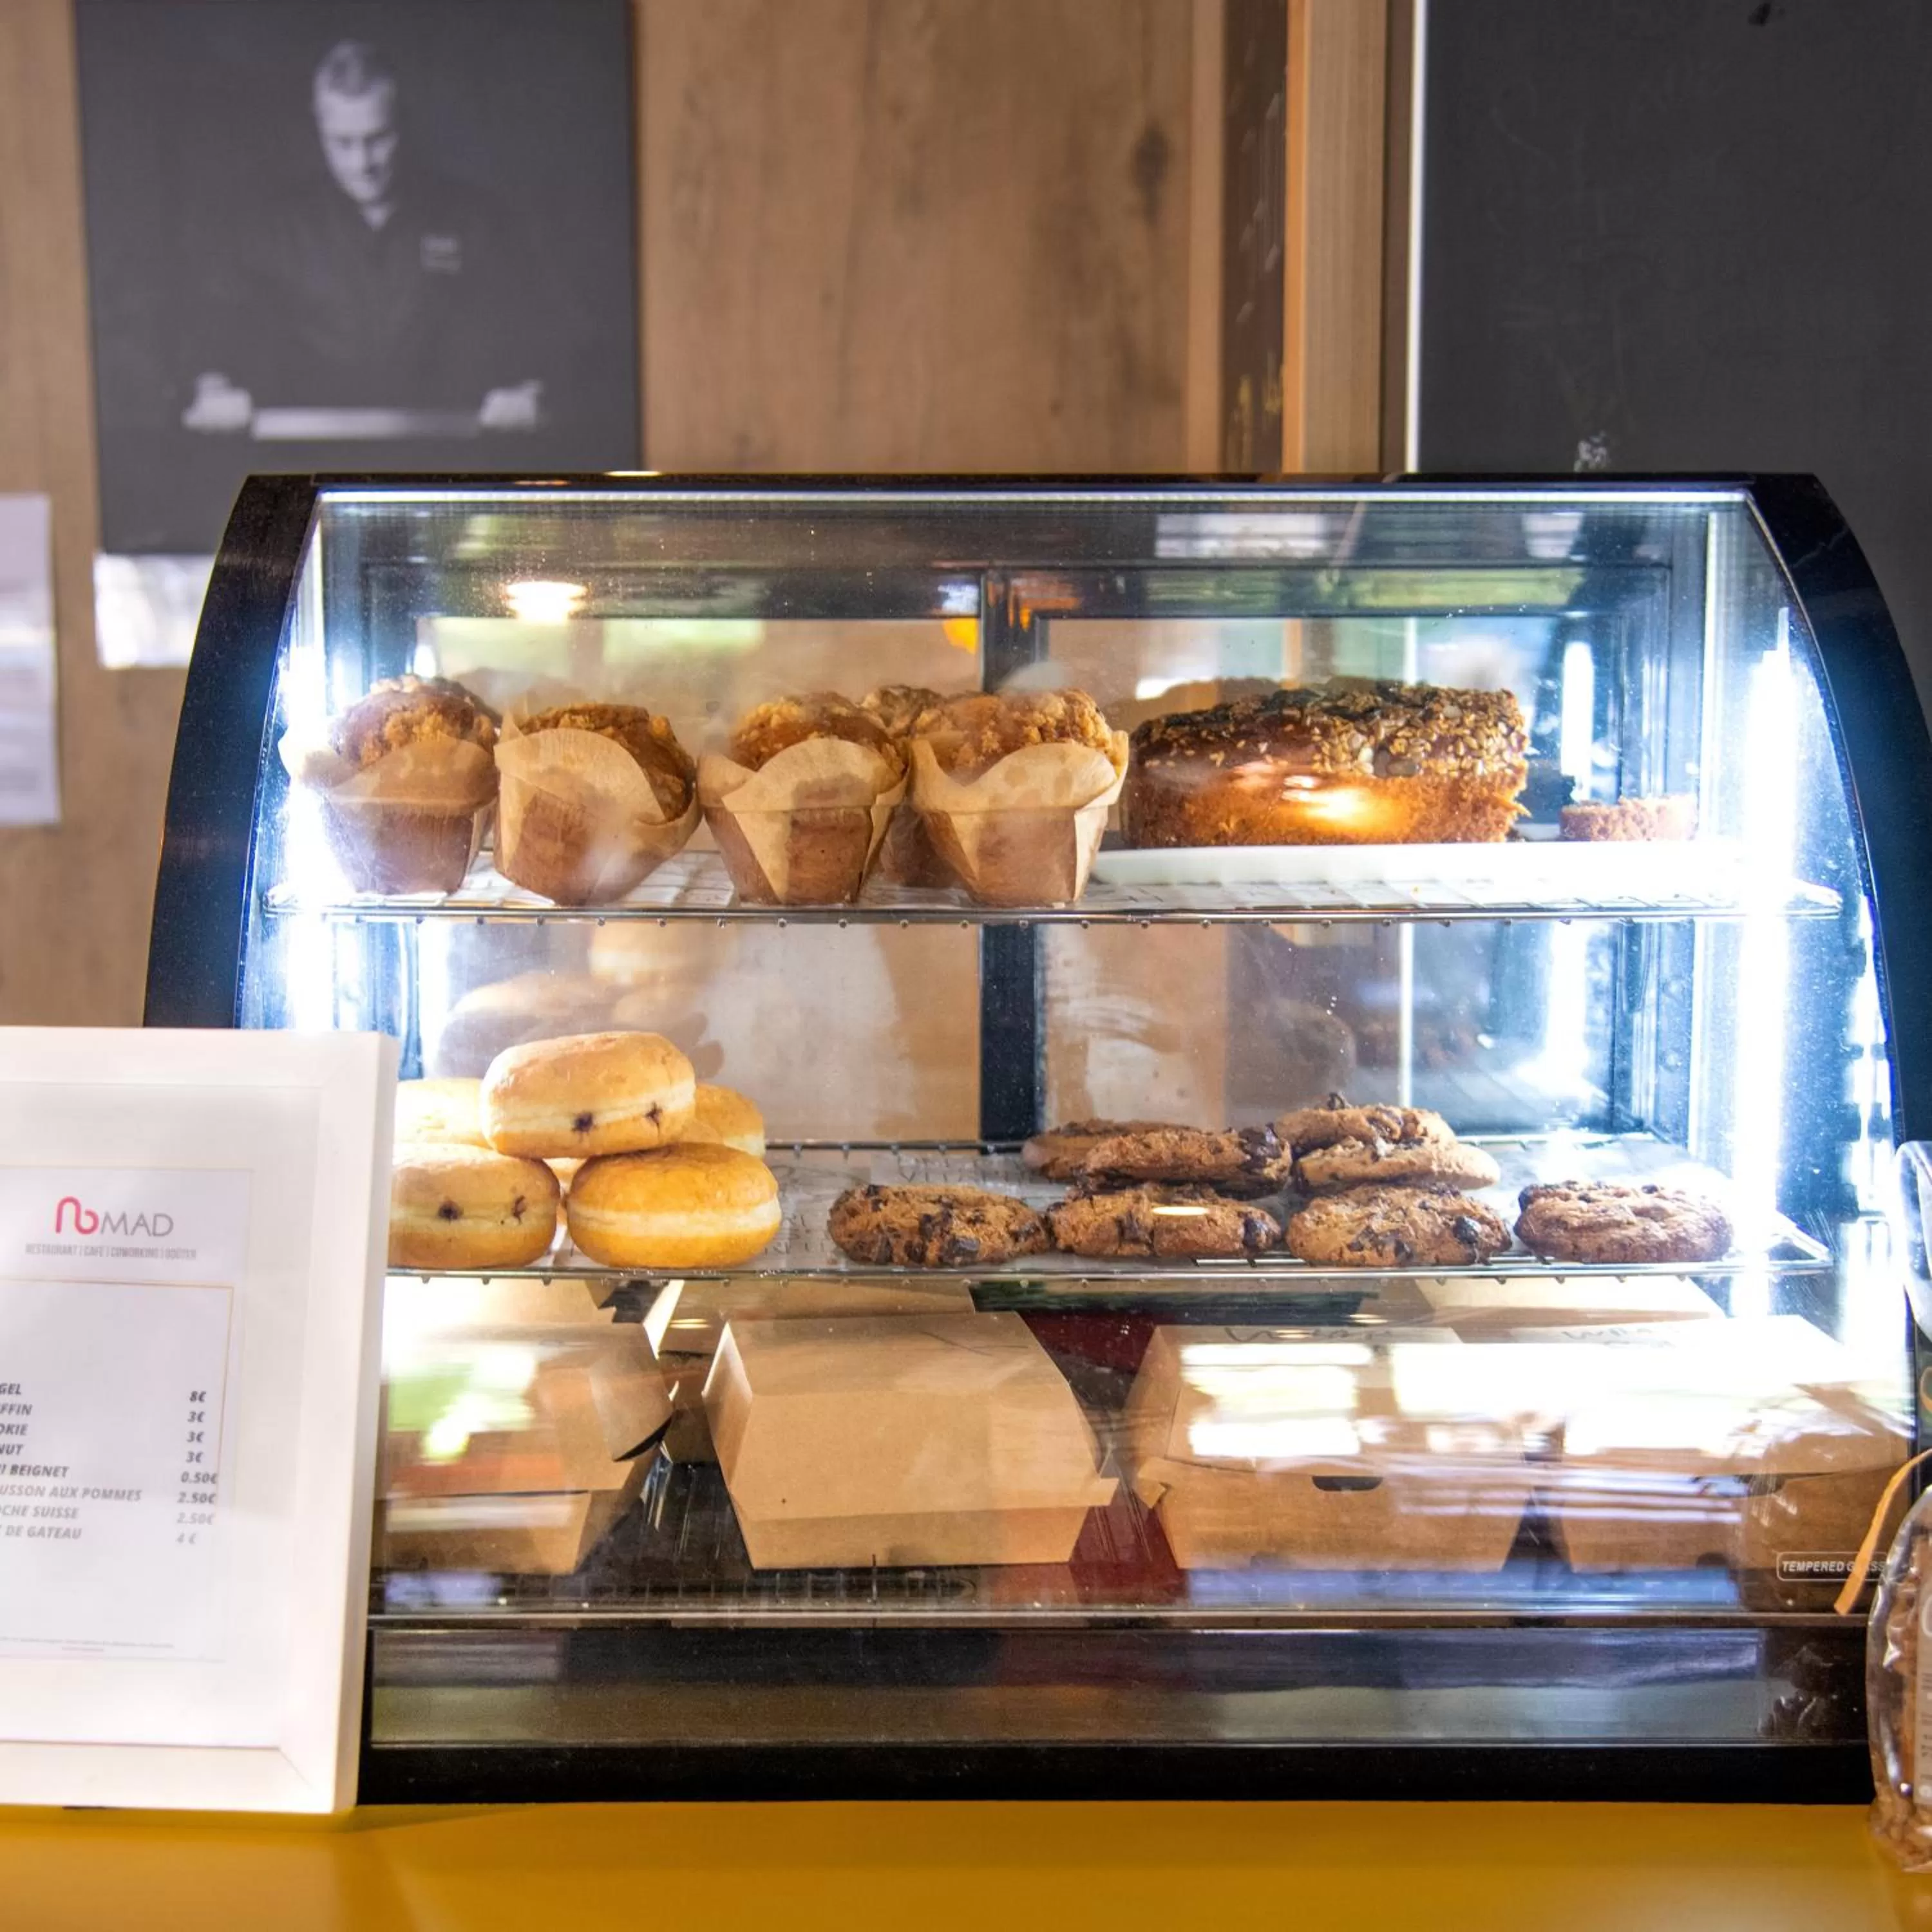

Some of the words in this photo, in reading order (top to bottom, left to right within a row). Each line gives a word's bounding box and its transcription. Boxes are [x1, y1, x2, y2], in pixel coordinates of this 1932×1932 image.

[189, 1391, 207, 1403] 8€
[187, 1411, 205, 1423] 3€
[186, 1432, 205, 1443] 3€
[185, 1452, 204, 1463] 3€
[10, 1464, 70, 1478] BEIGNET
[180, 1472, 218, 1484] 0.50€
[49, 1486, 79, 1499] AUX
[82, 1488, 142, 1502] POMMES
[177, 1492, 217, 1505] 2.50€
[32, 1506, 80, 1519] SUISSE
[176, 1512, 215, 1525] 2.50€
[5, 1524, 24, 1536] DE
[26, 1526, 82, 1540] GATEAU
[1782, 1560, 1844, 1572] TEMPERED
